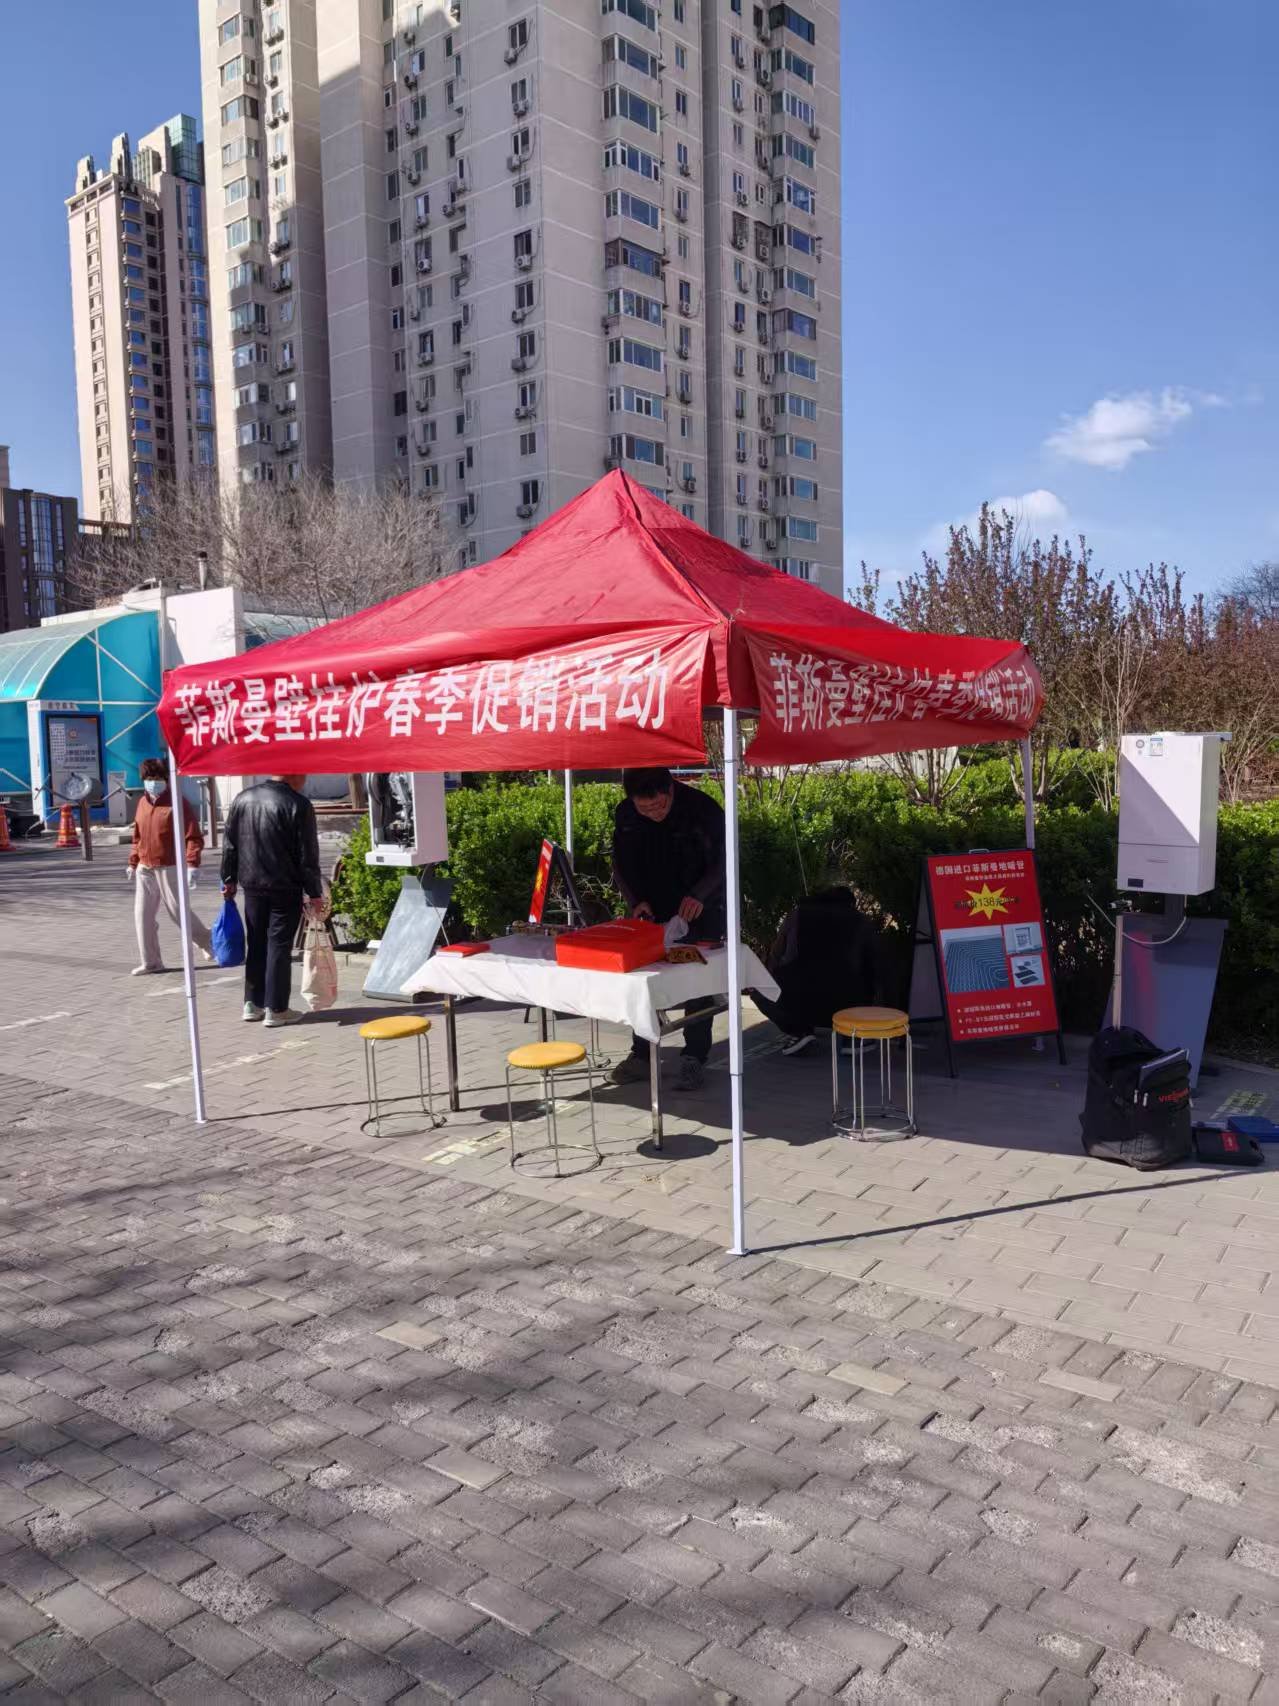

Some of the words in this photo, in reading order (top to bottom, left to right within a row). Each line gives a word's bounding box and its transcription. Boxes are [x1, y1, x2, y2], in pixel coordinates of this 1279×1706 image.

[174, 648, 668, 745] 菲斯曼壁挂炉春季促销活动
